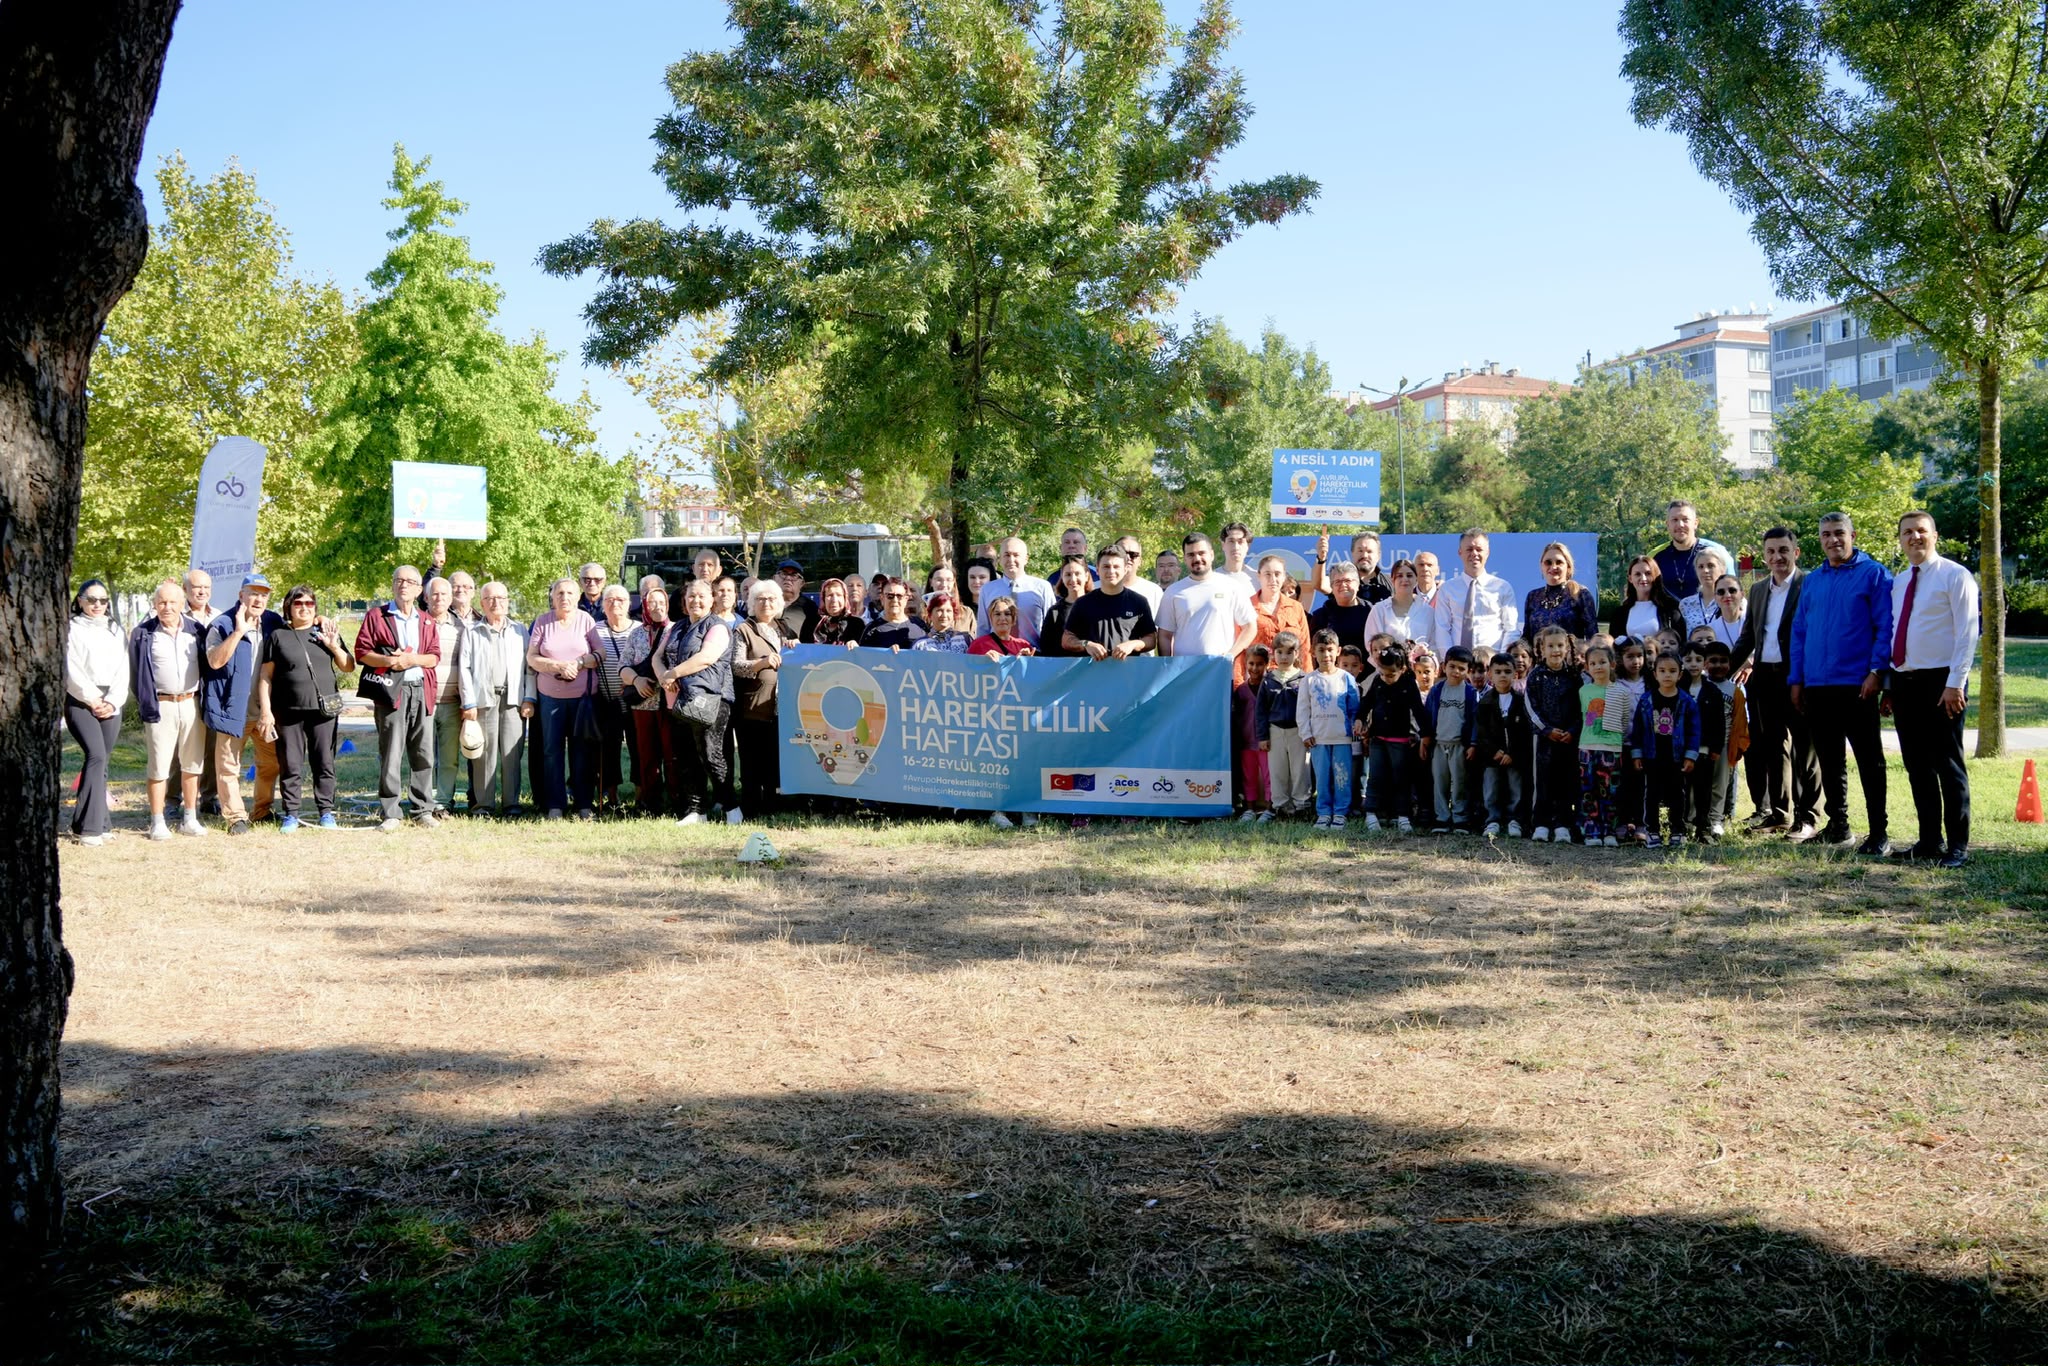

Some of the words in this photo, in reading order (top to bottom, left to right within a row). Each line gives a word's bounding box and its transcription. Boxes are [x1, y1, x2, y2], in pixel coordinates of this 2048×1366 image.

[1280, 454, 1288, 465] 4
[1291, 452, 1328, 465] NESİL
[1331, 455, 1336, 465] 1
[1339, 455, 1375, 467] ADIM
[1320, 487, 1348, 495] HAFTASI
[1327, 549, 1424, 570] AVUPA
[898, 669, 1022, 702] AVRUPA
[900, 697, 1110, 733] HAREKETLİLİK
[902, 725, 1018, 760] HAFTASI
[903, 755, 936, 768] 16-22
[938, 758, 977, 773] EYLÜL
[979, 762, 1010, 776] 2026
[1114, 778, 1140, 787] aces
[1114, 785, 1140, 793] europe
